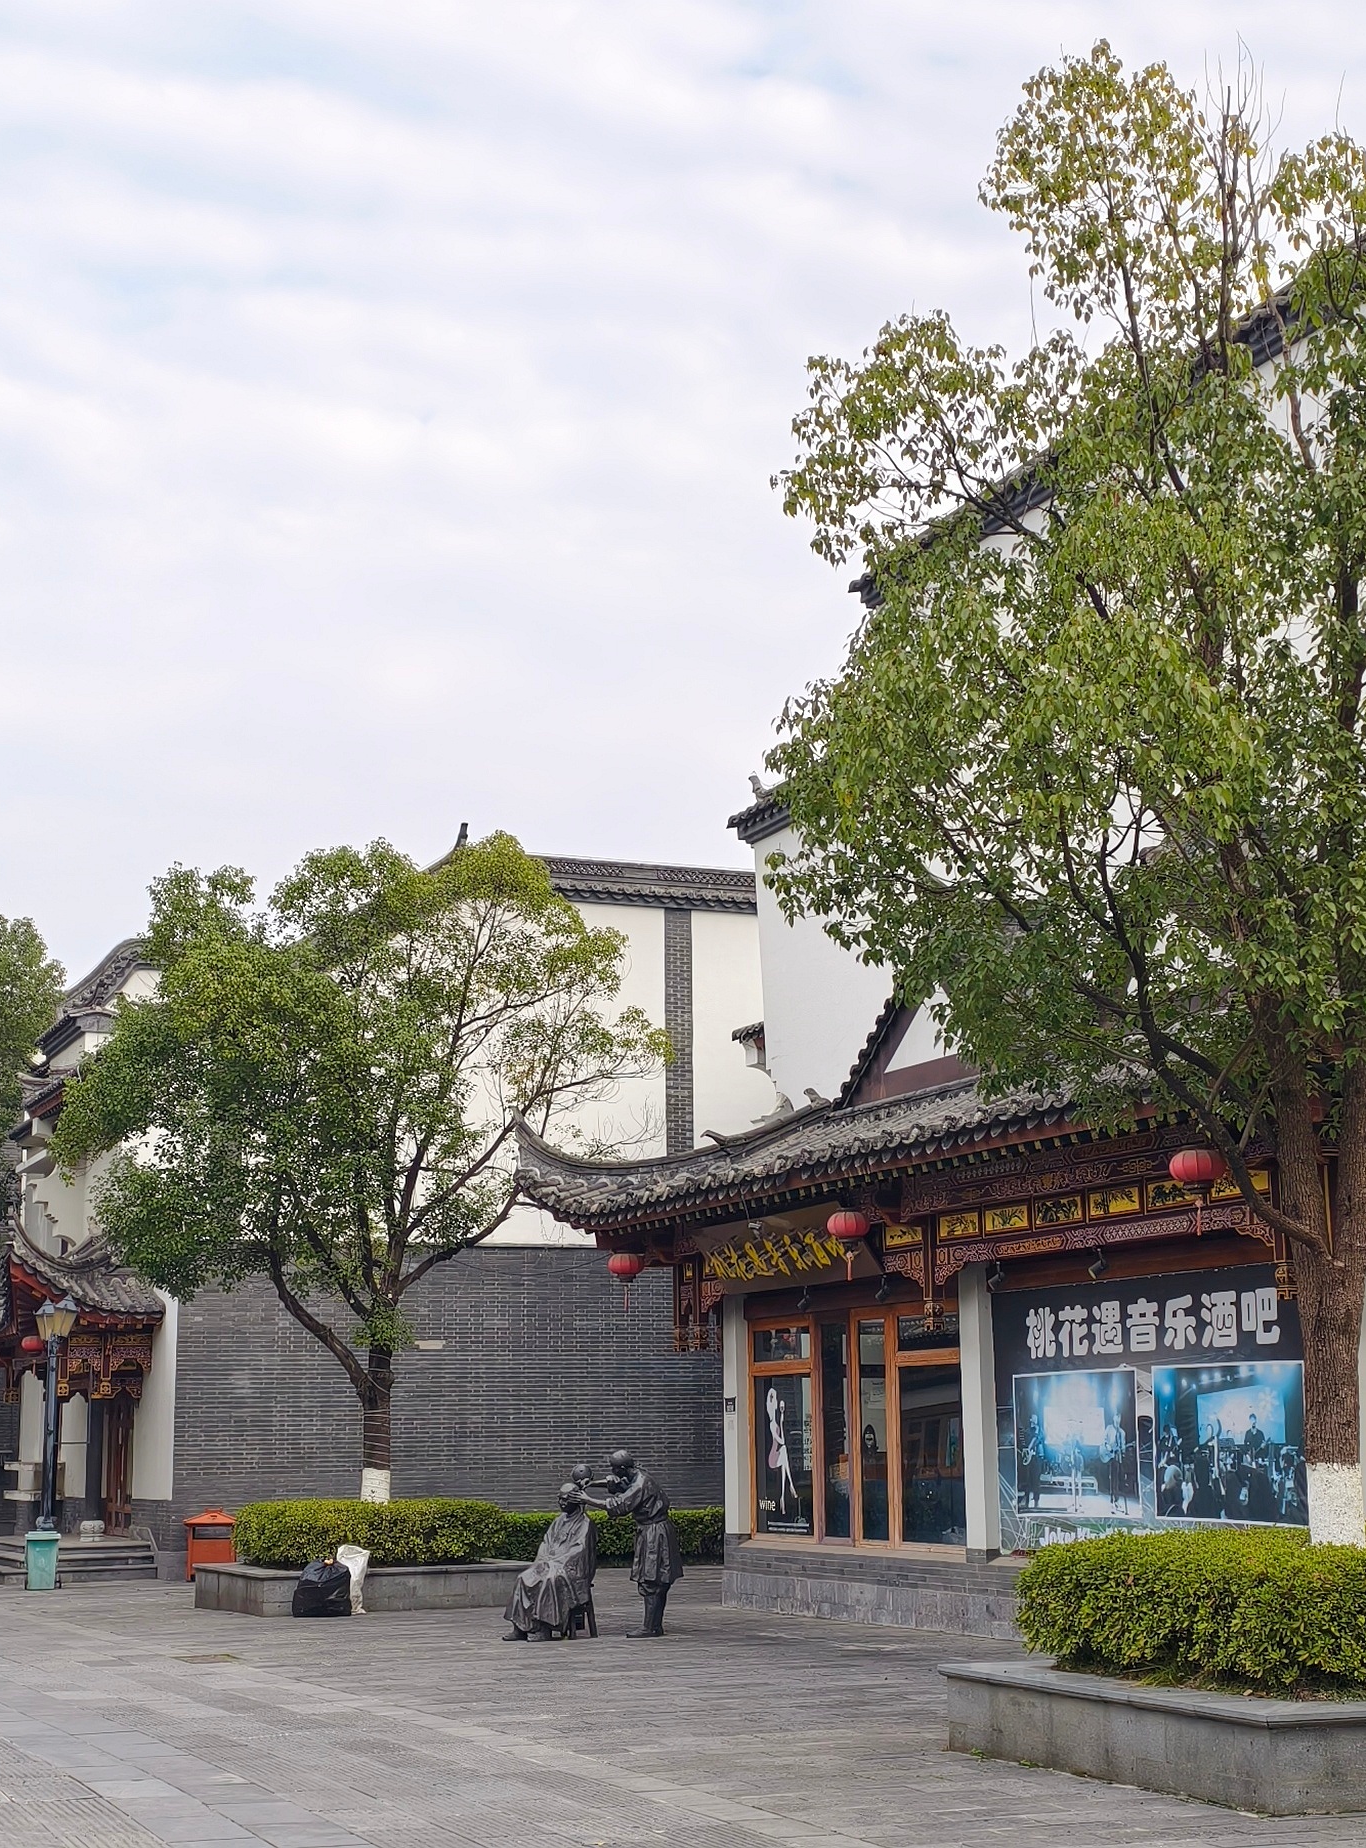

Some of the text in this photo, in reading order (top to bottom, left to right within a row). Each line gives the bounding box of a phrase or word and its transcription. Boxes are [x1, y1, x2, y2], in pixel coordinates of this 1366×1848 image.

[1025, 1287, 1282, 1360] 桃花遇音乐酒吧
[758, 1496, 777, 1512] wine
